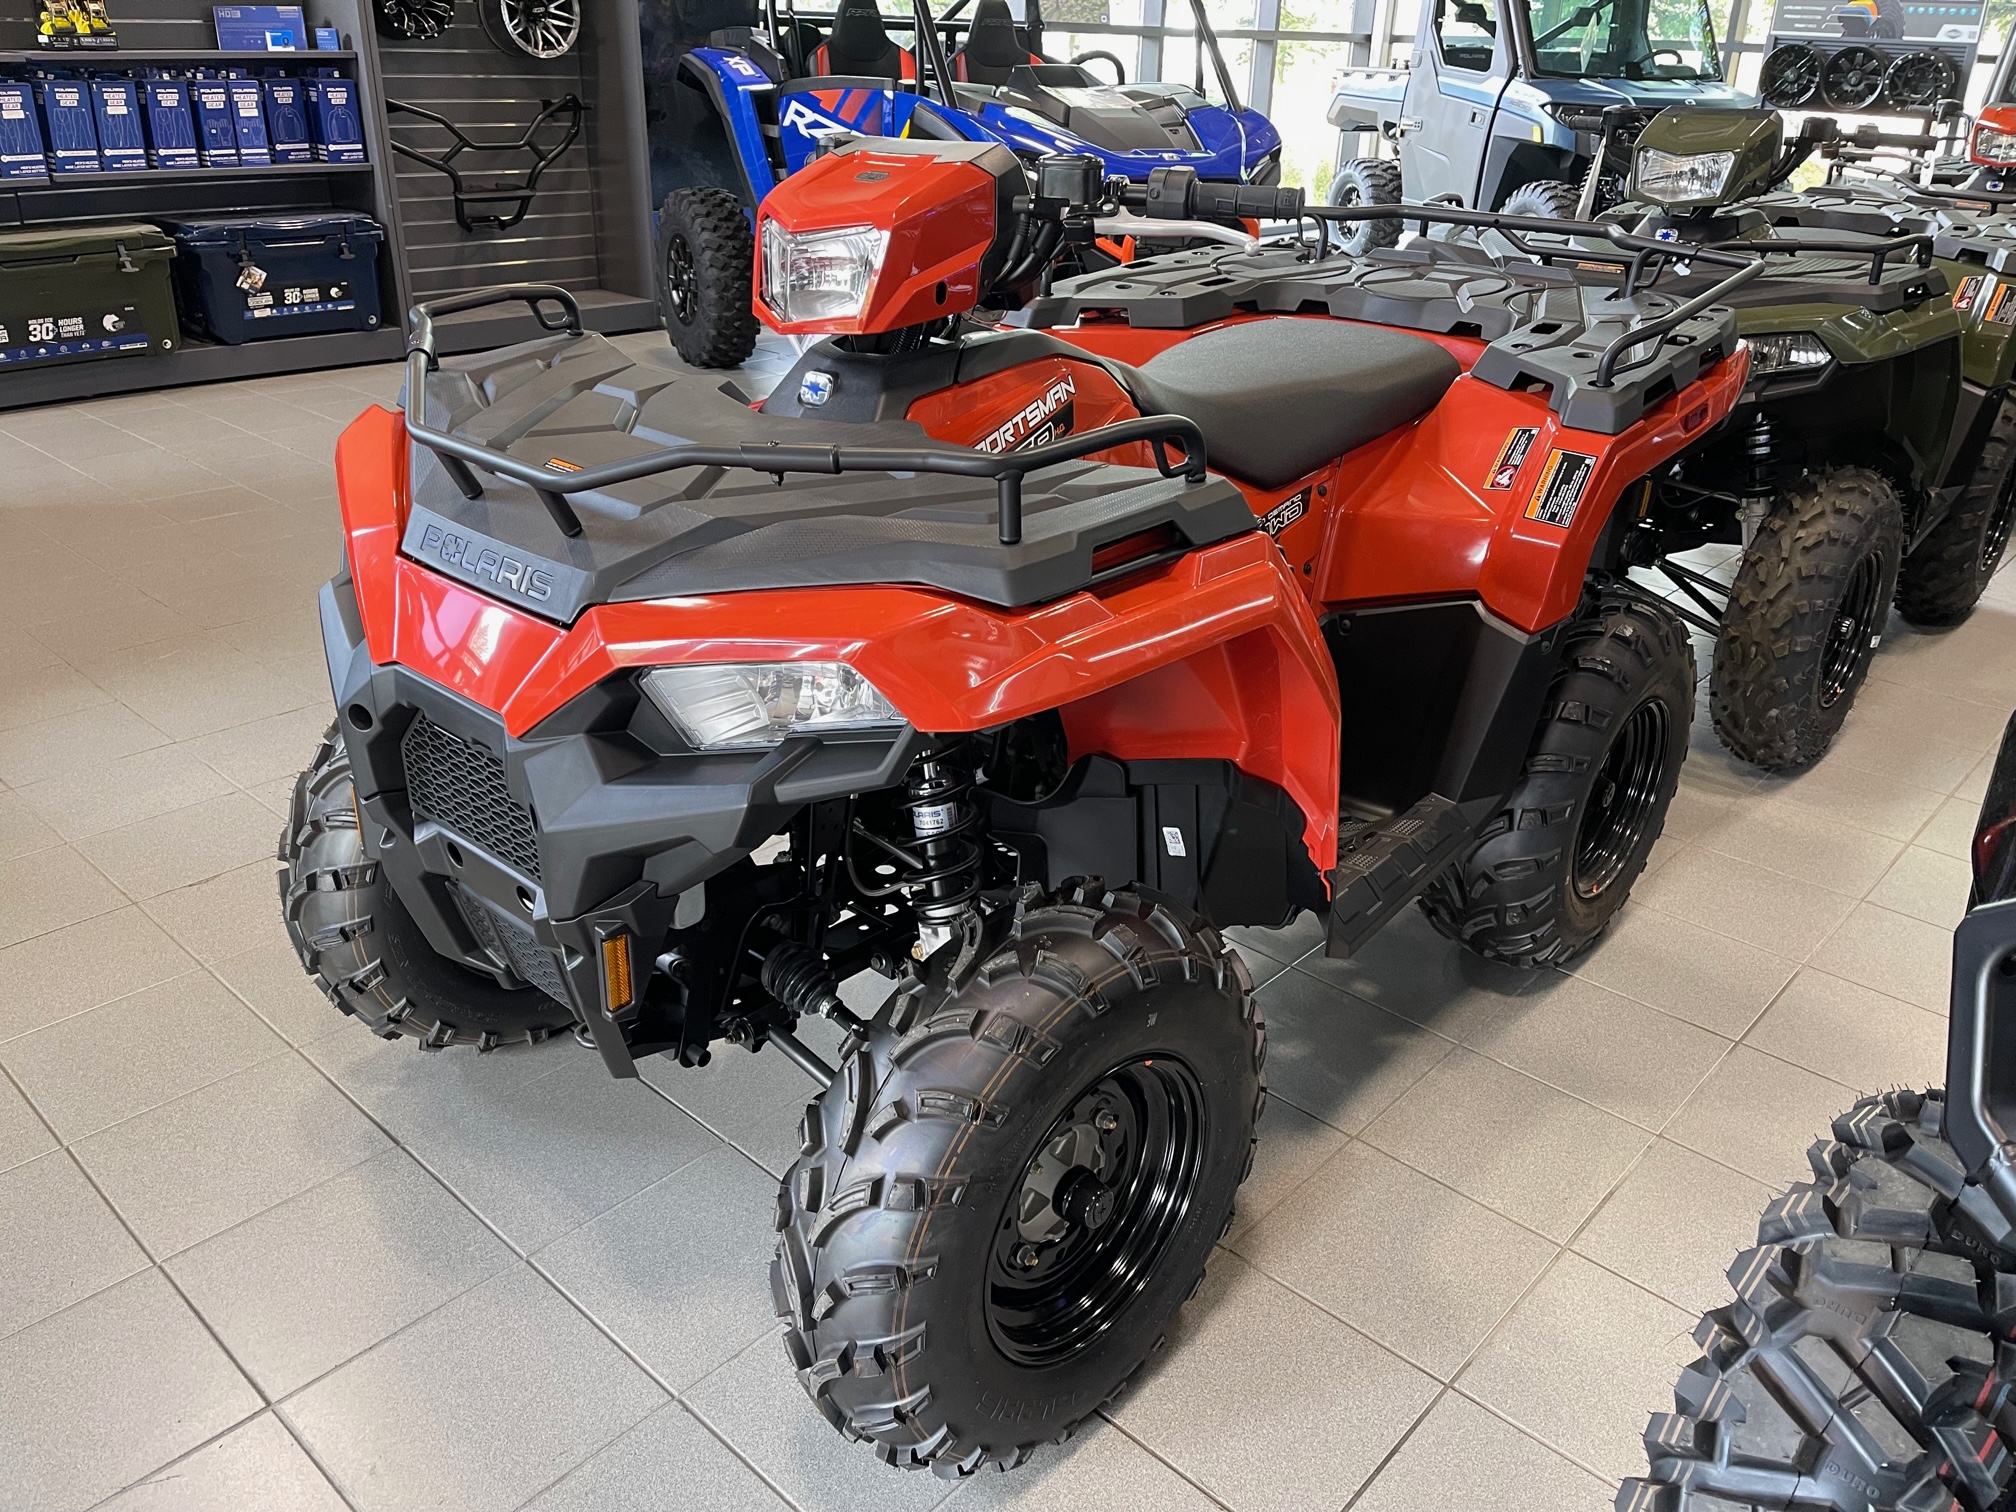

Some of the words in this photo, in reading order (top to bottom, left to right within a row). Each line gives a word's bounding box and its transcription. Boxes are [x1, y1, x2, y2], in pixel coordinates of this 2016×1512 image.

[846, 7, 878, 18] RZR
[722, 56, 756, 76] XP
[782, 99, 868, 139] RZ
[58, 317, 82, 326] HOURS
[60, 324, 84, 333] LONGER
[974, 374, 1076, 454] ORTSMAN
[1539, 465, 1553, 495] WARNING
[1268, 494, 1301, 520] DEMAND
[420, 524, 554, 602] POLARIS
[1950, 1229, 2000, 1265] DURO
[1814, 1298, 1867, 1325] DURO
[1825, 1460, 1881, 1500] DURO
